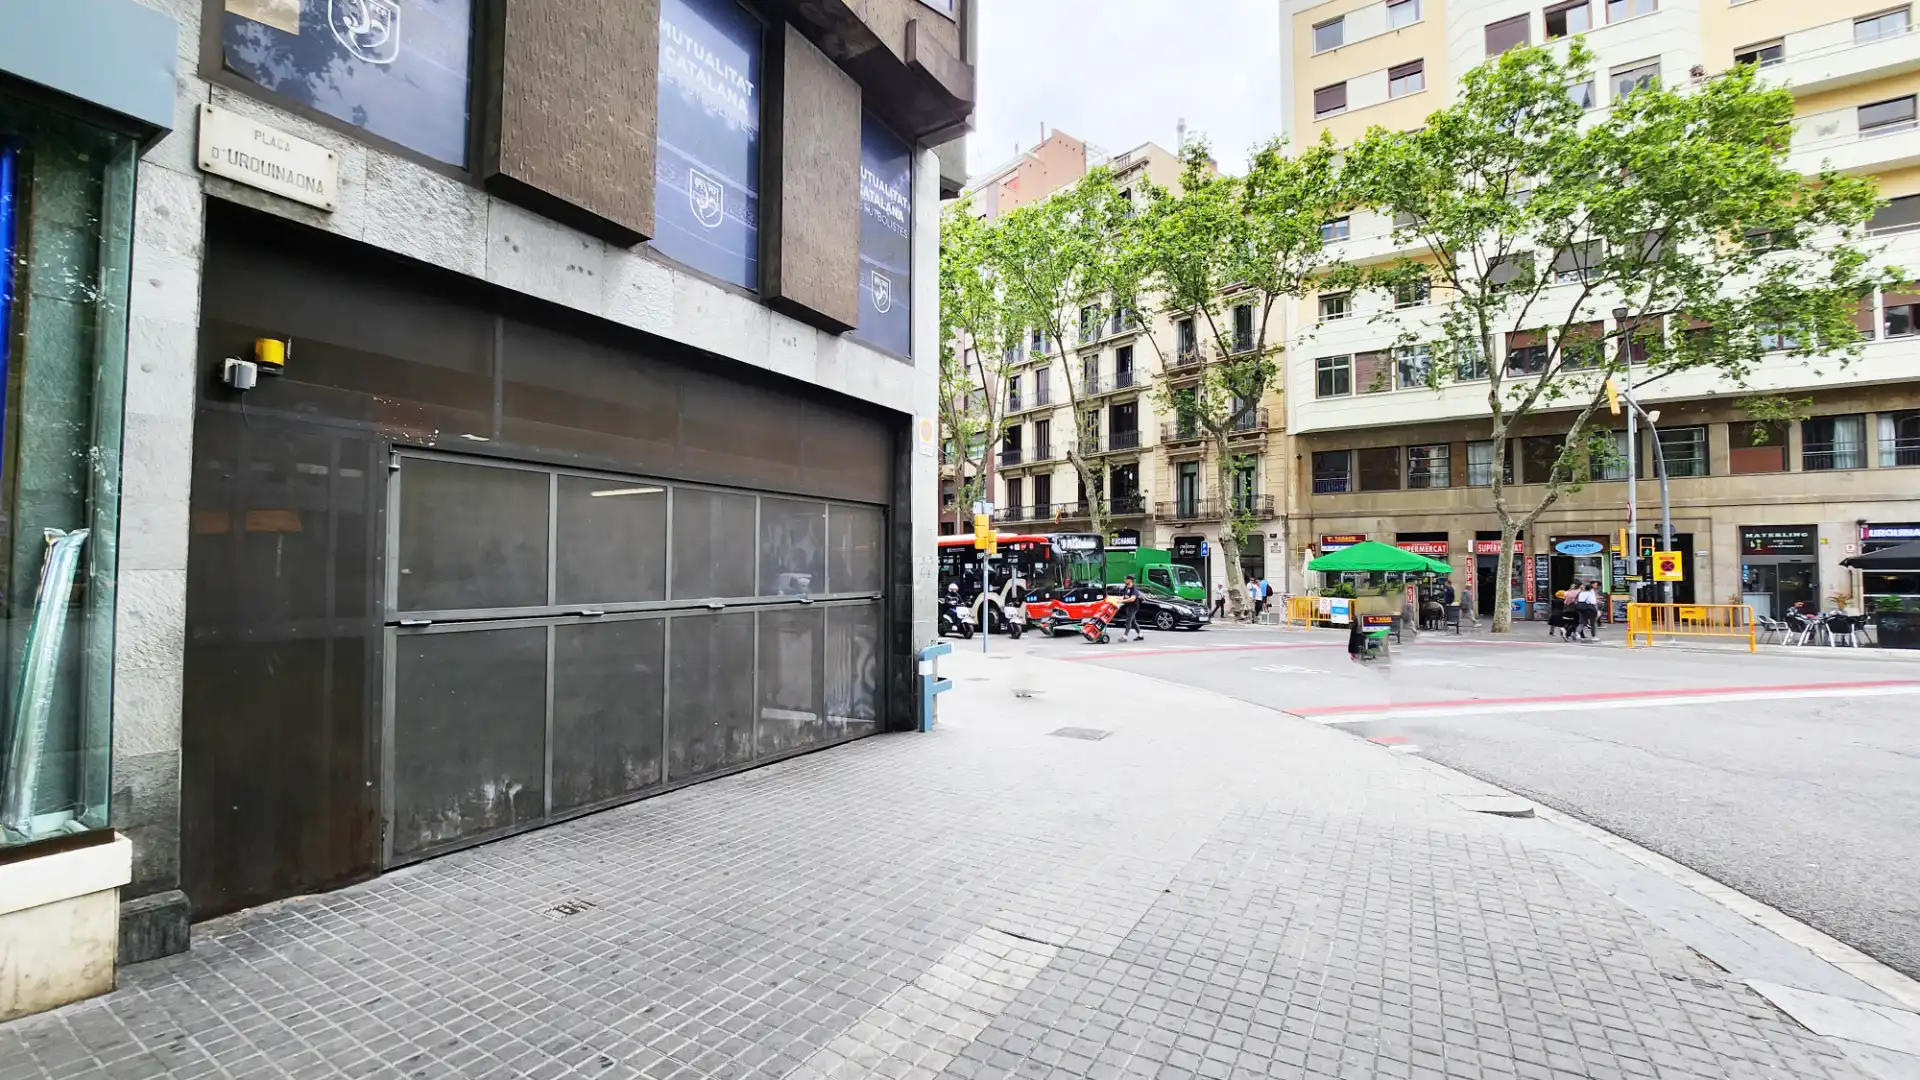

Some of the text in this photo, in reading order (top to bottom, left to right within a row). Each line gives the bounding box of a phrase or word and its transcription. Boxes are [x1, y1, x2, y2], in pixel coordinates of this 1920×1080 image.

[659, 15, 754, 97] MUTUALITAT
[665, 44, 748, 113] CATALANA
[860, 164, 908, 209] UTUALITAT
[1478, 543, 1523, 552] SUPERAT
